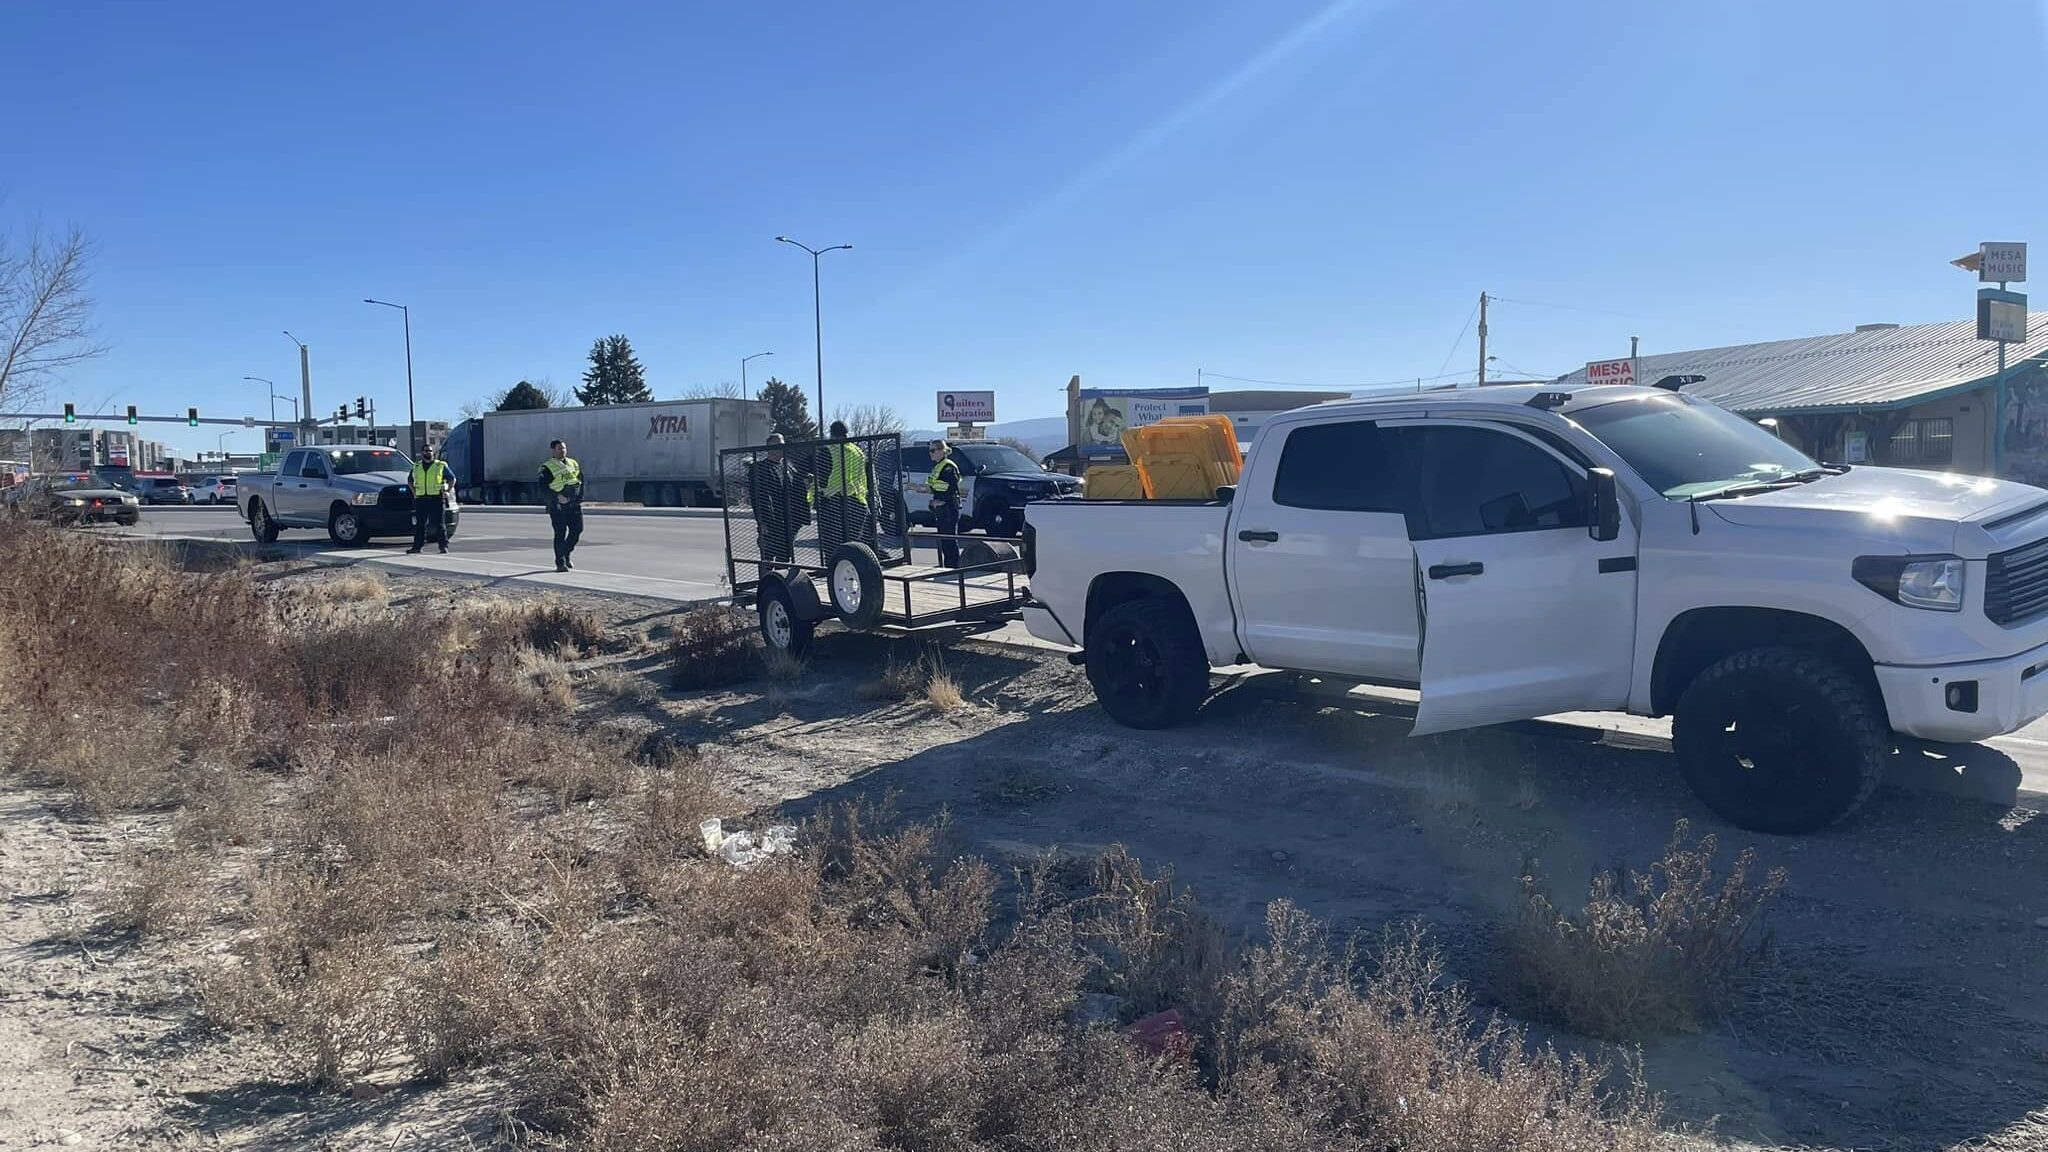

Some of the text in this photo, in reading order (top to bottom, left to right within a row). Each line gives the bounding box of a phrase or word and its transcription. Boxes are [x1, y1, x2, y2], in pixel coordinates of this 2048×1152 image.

[1991, 250, 2021, 260] MESA
[1987, 263, 2024, 273] MUSIC
[1589, 361, 1631, 377] MESA
[944, 394, 985, 410] Quilters
[1134, 402, 1166, 412] Protect
[941, 408, 992, 419] Inspiration
[1138, 412, 1162, 421] What
[646, 414, 688, 440] XTRA
